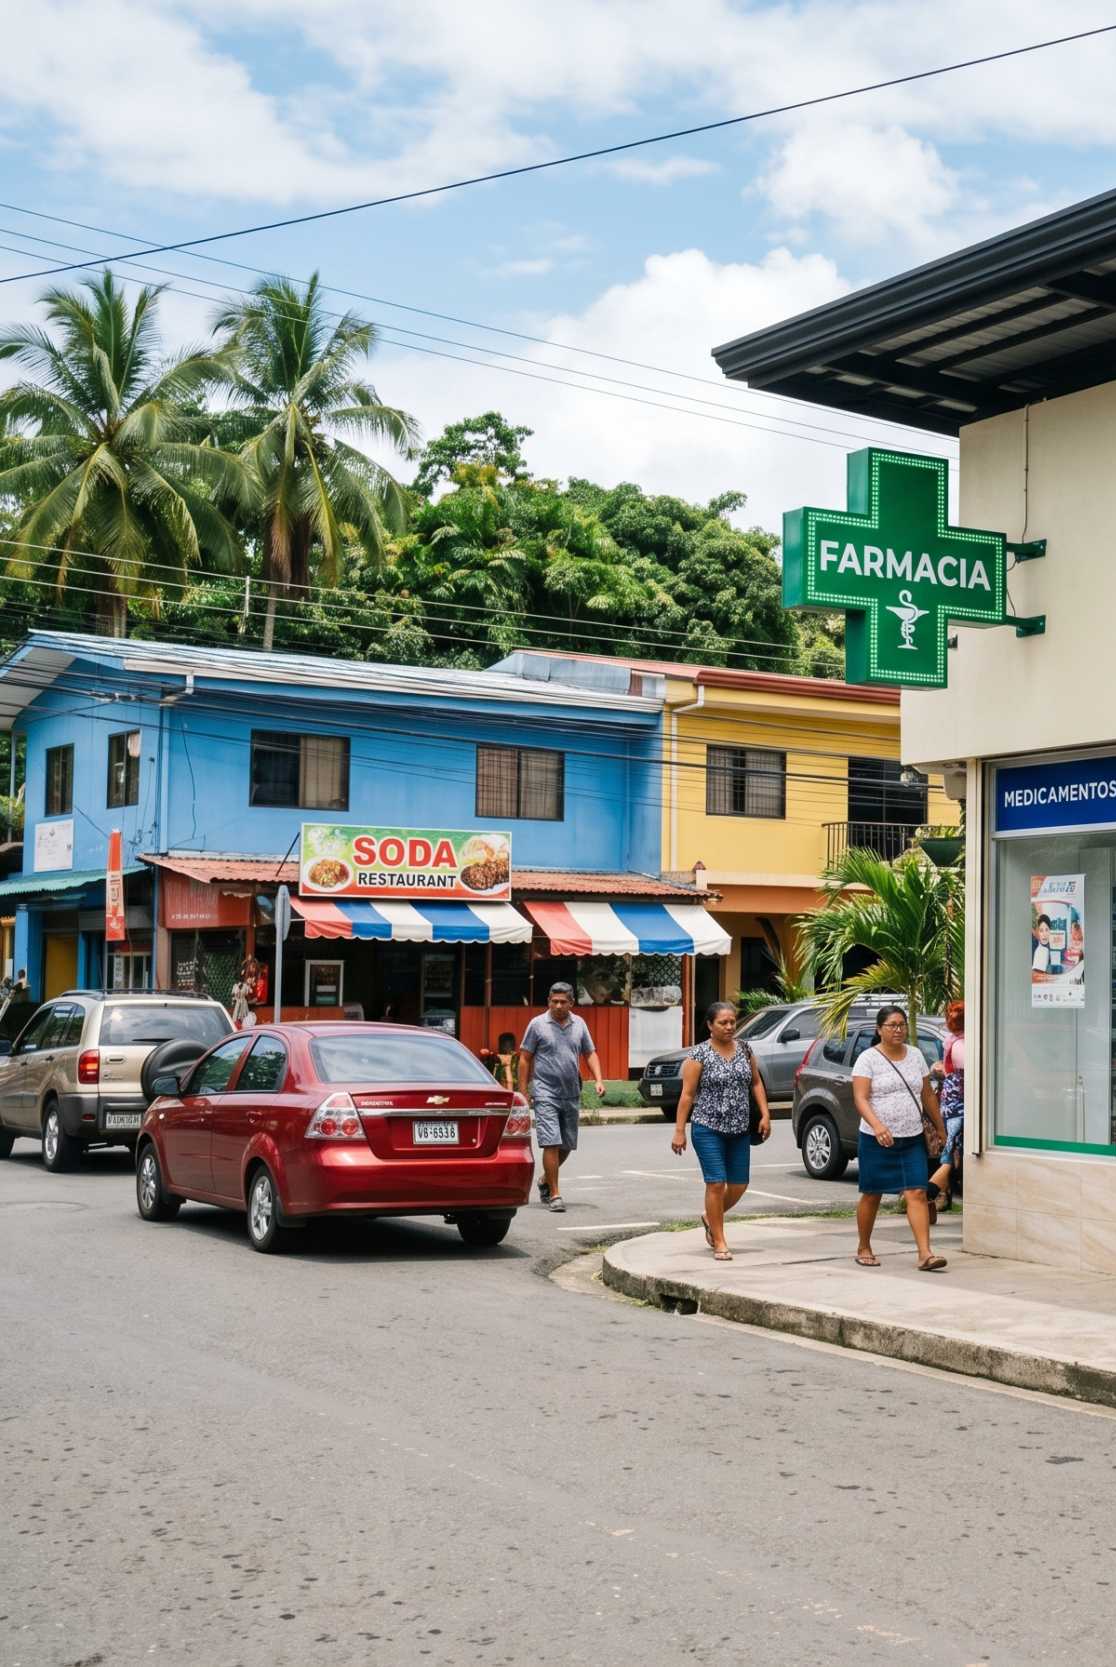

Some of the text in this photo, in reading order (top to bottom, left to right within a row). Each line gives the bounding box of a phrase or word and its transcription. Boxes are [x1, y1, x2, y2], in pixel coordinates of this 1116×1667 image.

[818, 539, 992, 592] FARMACIA
[353, 837, 458, 868] SODA
[358, 872, 457, 888] RESTAURANT
